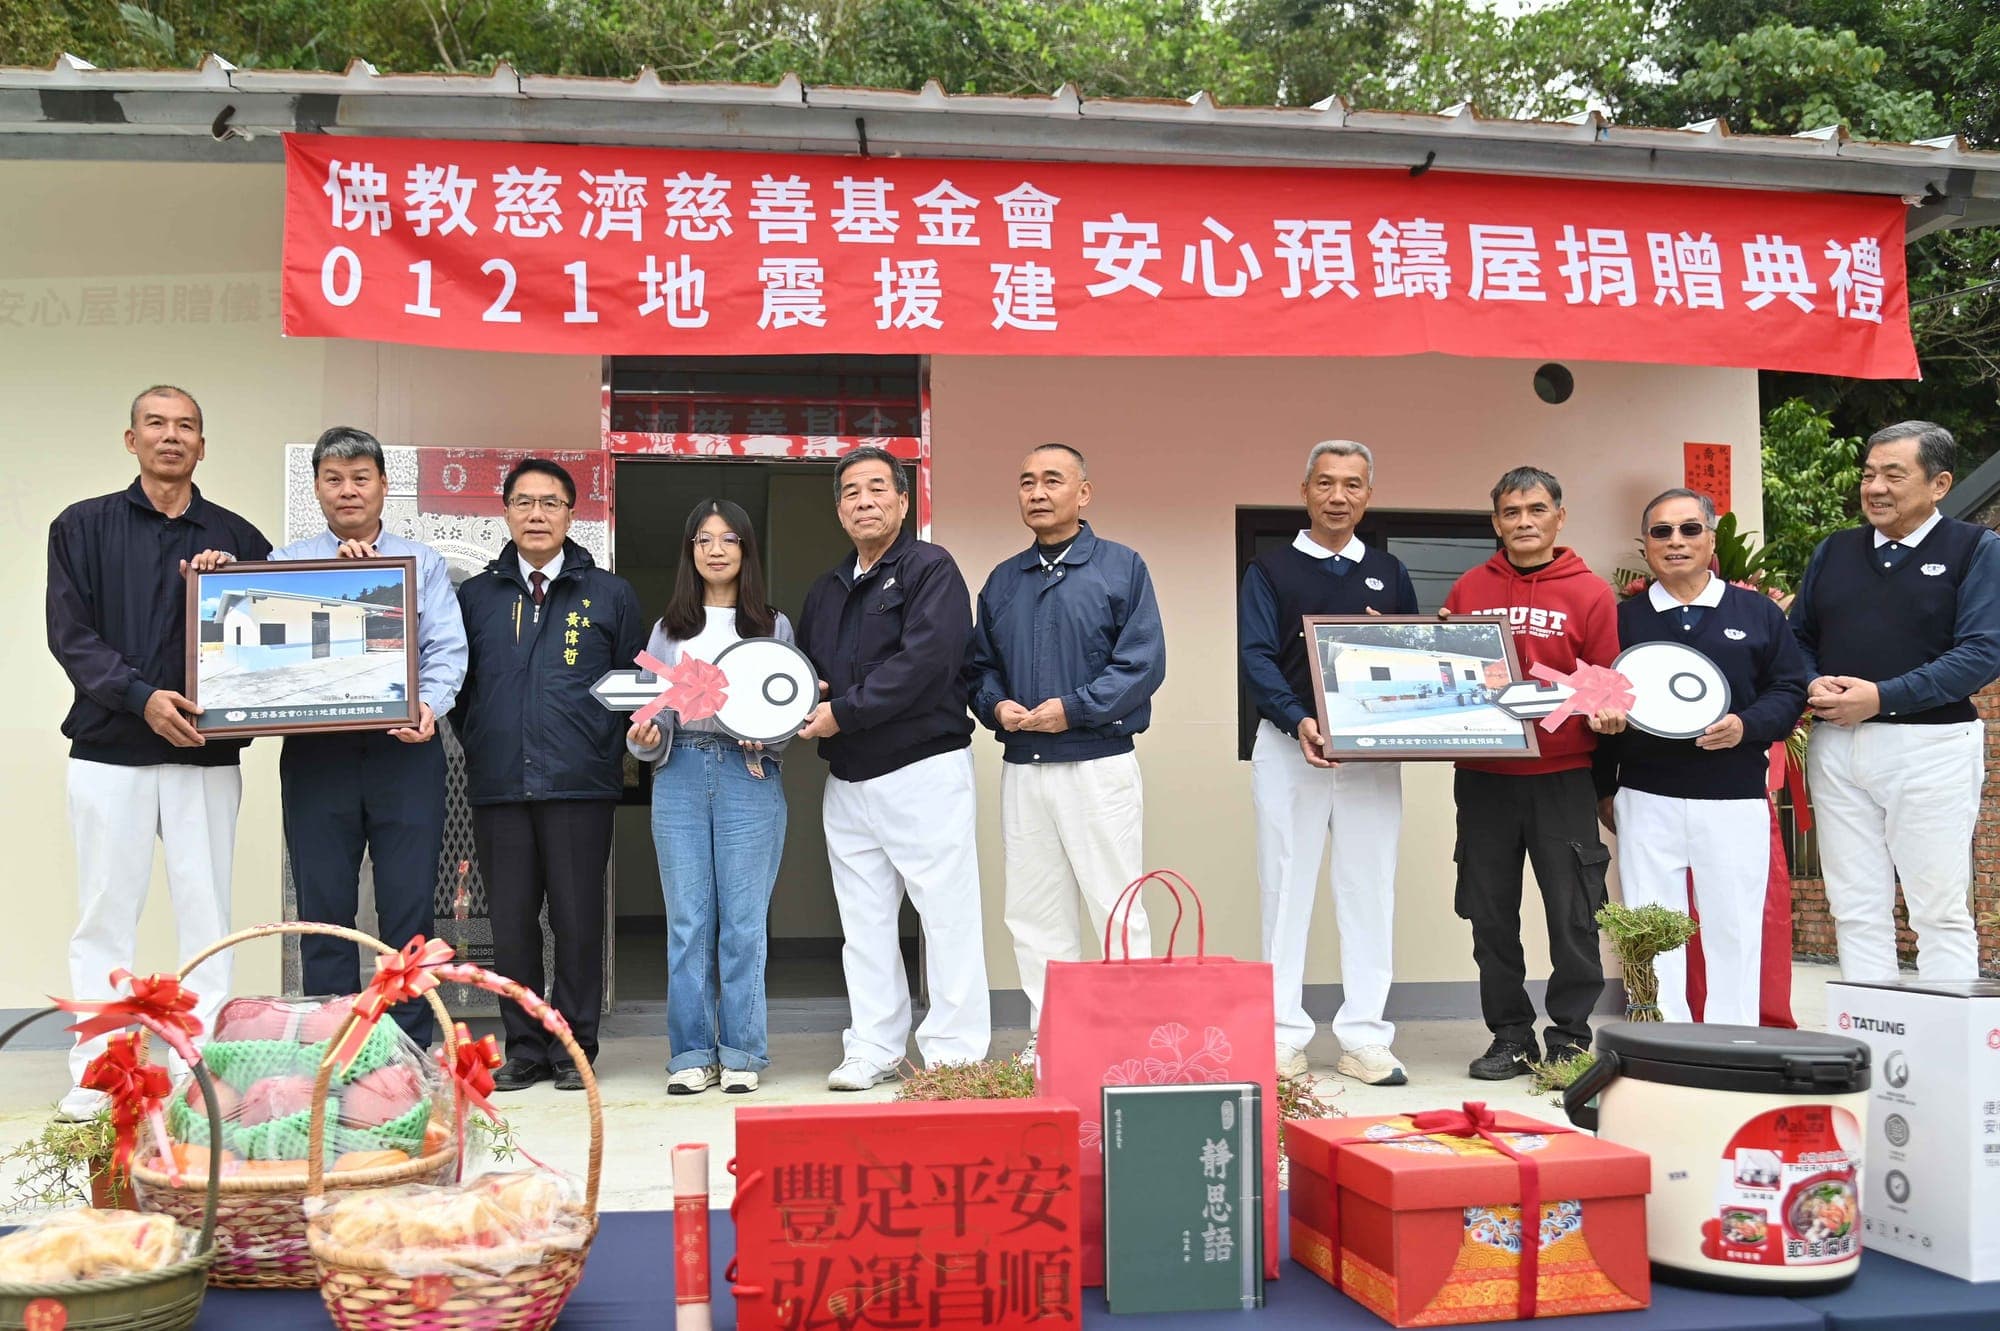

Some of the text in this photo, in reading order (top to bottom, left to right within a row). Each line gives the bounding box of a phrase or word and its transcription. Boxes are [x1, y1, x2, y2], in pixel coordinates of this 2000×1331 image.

[323, 159, 1060, 250] 佛教慈濟慈善基金會
[321, 245, 1060, 331] 0121地震援建
[1082, 212, 1885, 325] 安心預鑄屋捐贈典禮
[563, 611, 581, 666] 黃偉哲
[1471, 606, 1567, 630] UST
[1852, 1016, 1905, 1036] TATUNG
[769, 1156, 1073, 1242] 豐足平安
[1199, 1138, 1235, 1262] 靜思語
[769, 1245, 1074, 1331] 弘運昌順
